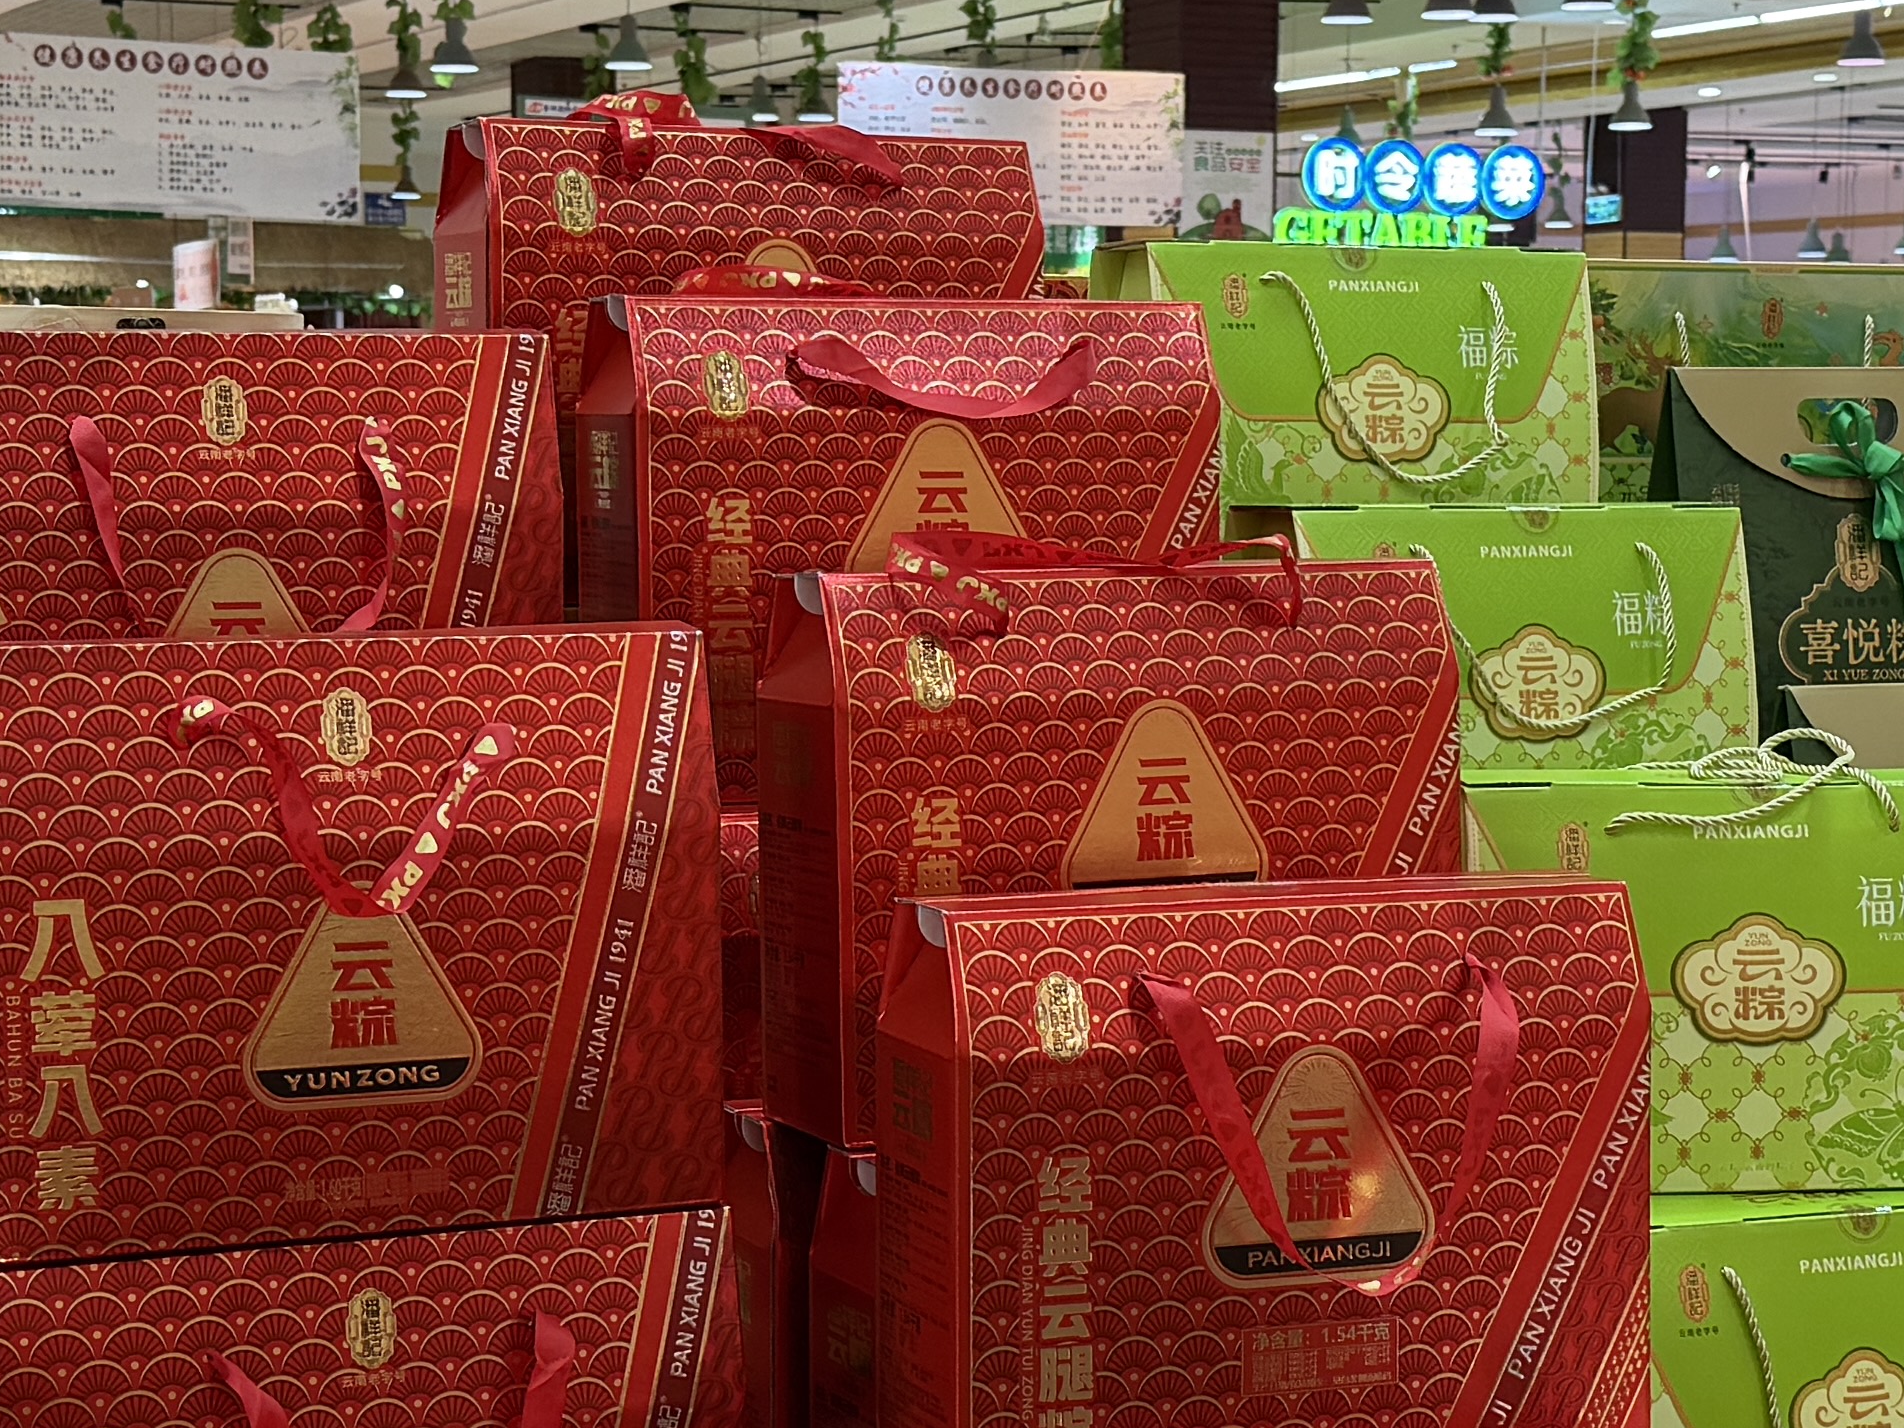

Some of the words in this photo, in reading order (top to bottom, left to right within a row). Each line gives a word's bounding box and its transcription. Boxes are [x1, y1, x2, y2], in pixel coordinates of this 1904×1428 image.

[1314, 148, 1536, 206] 时令蔬菜
[1327, 278, 1420, 294] PANXIANGJI
[1479, 544, 1573, 560] PANXIANGJI
[1135, 755, 1194, 863] 云粽
[609, 918, 634, 963] 1941
[330, 942, 396, 1048] 云粽
[603, 972, 622, 990] JI
[1733, 948, 1786, 1022] 云粽
[21, 898, 105, 1210] 八荤八素
[585, 996, 616, 1064] XIANG
[283, 1062, 441, 1090] YUNZONG
[574, 1060, 600, 1111] PAN
[1286, 1108, 1354, 1221] 云粽
[1799, 1252, 1904, 1273] PANXIANGJI
[1509, 1321, 1546, 1381] PAN
[1537, 1235, 1583, 1322] XIANG
[1576, 1207, 1596, 1236] JI
